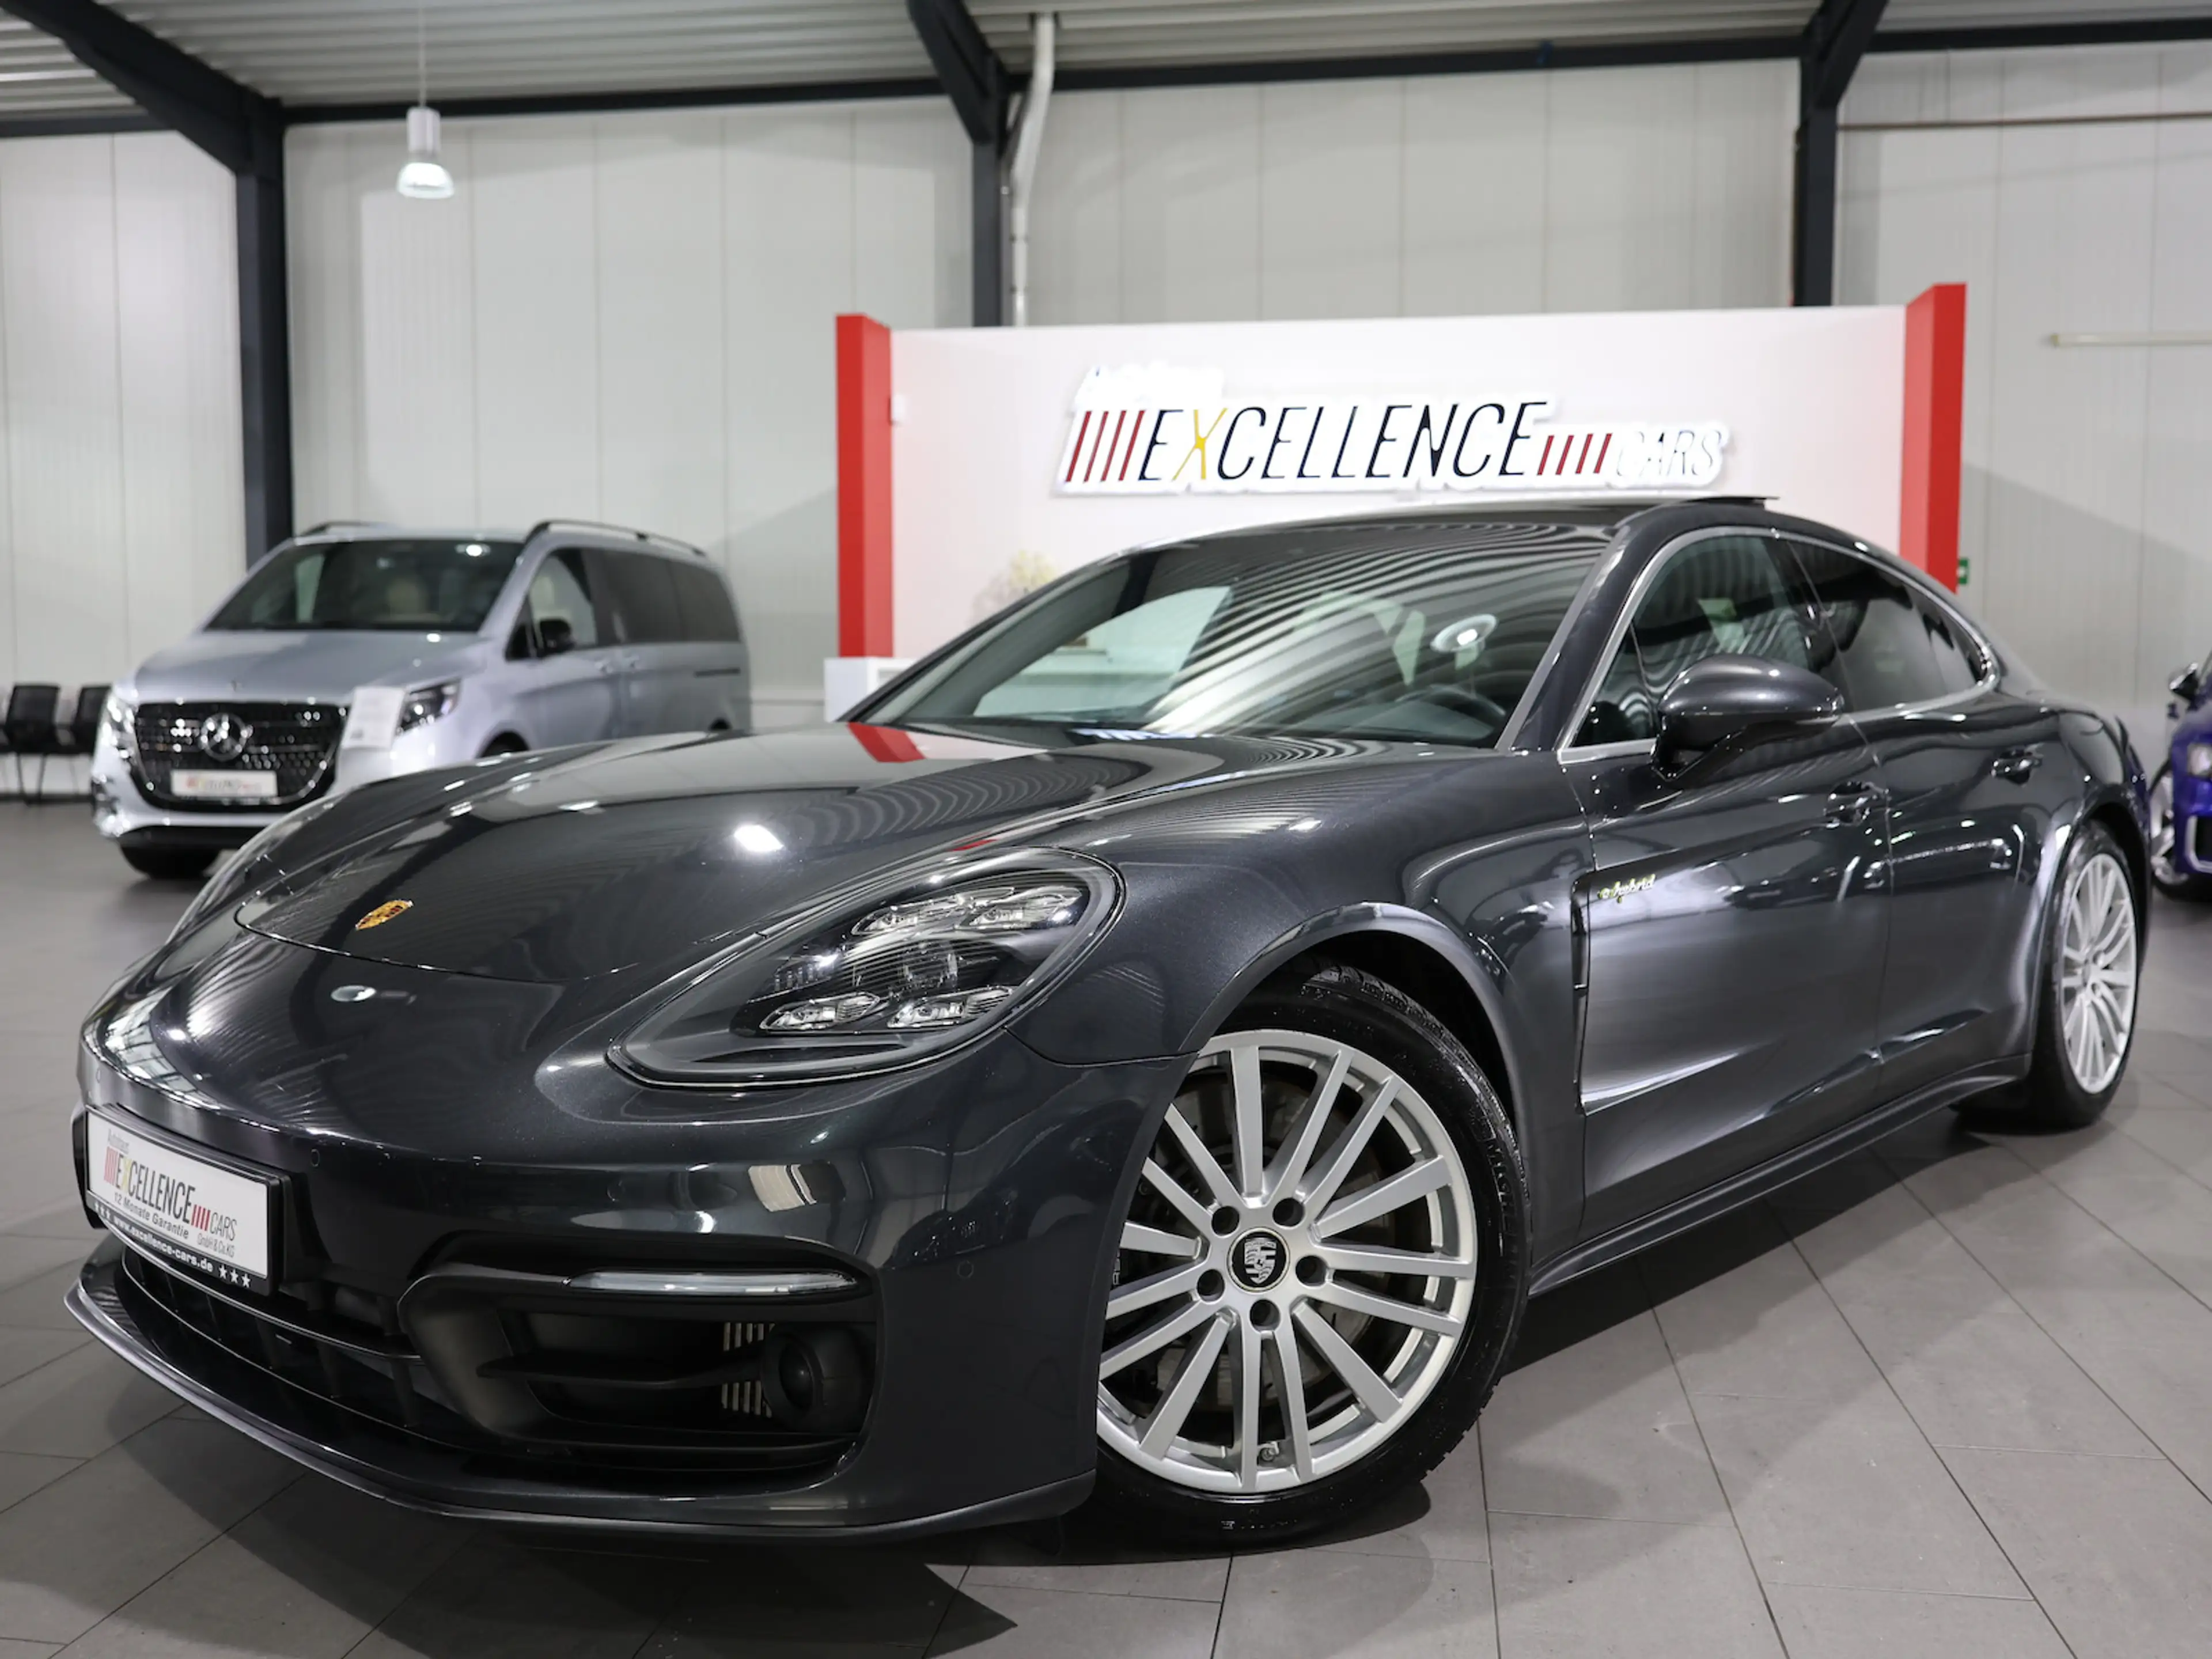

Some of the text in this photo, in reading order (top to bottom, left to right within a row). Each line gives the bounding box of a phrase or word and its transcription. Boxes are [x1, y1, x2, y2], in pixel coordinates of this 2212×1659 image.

[1138, 402, 1722, 481] EXCELLENCE CARS
[116, 1153, 237, 1241] EXCELLENCE CARS
[152, 1212, 189, 1240] Garantie
